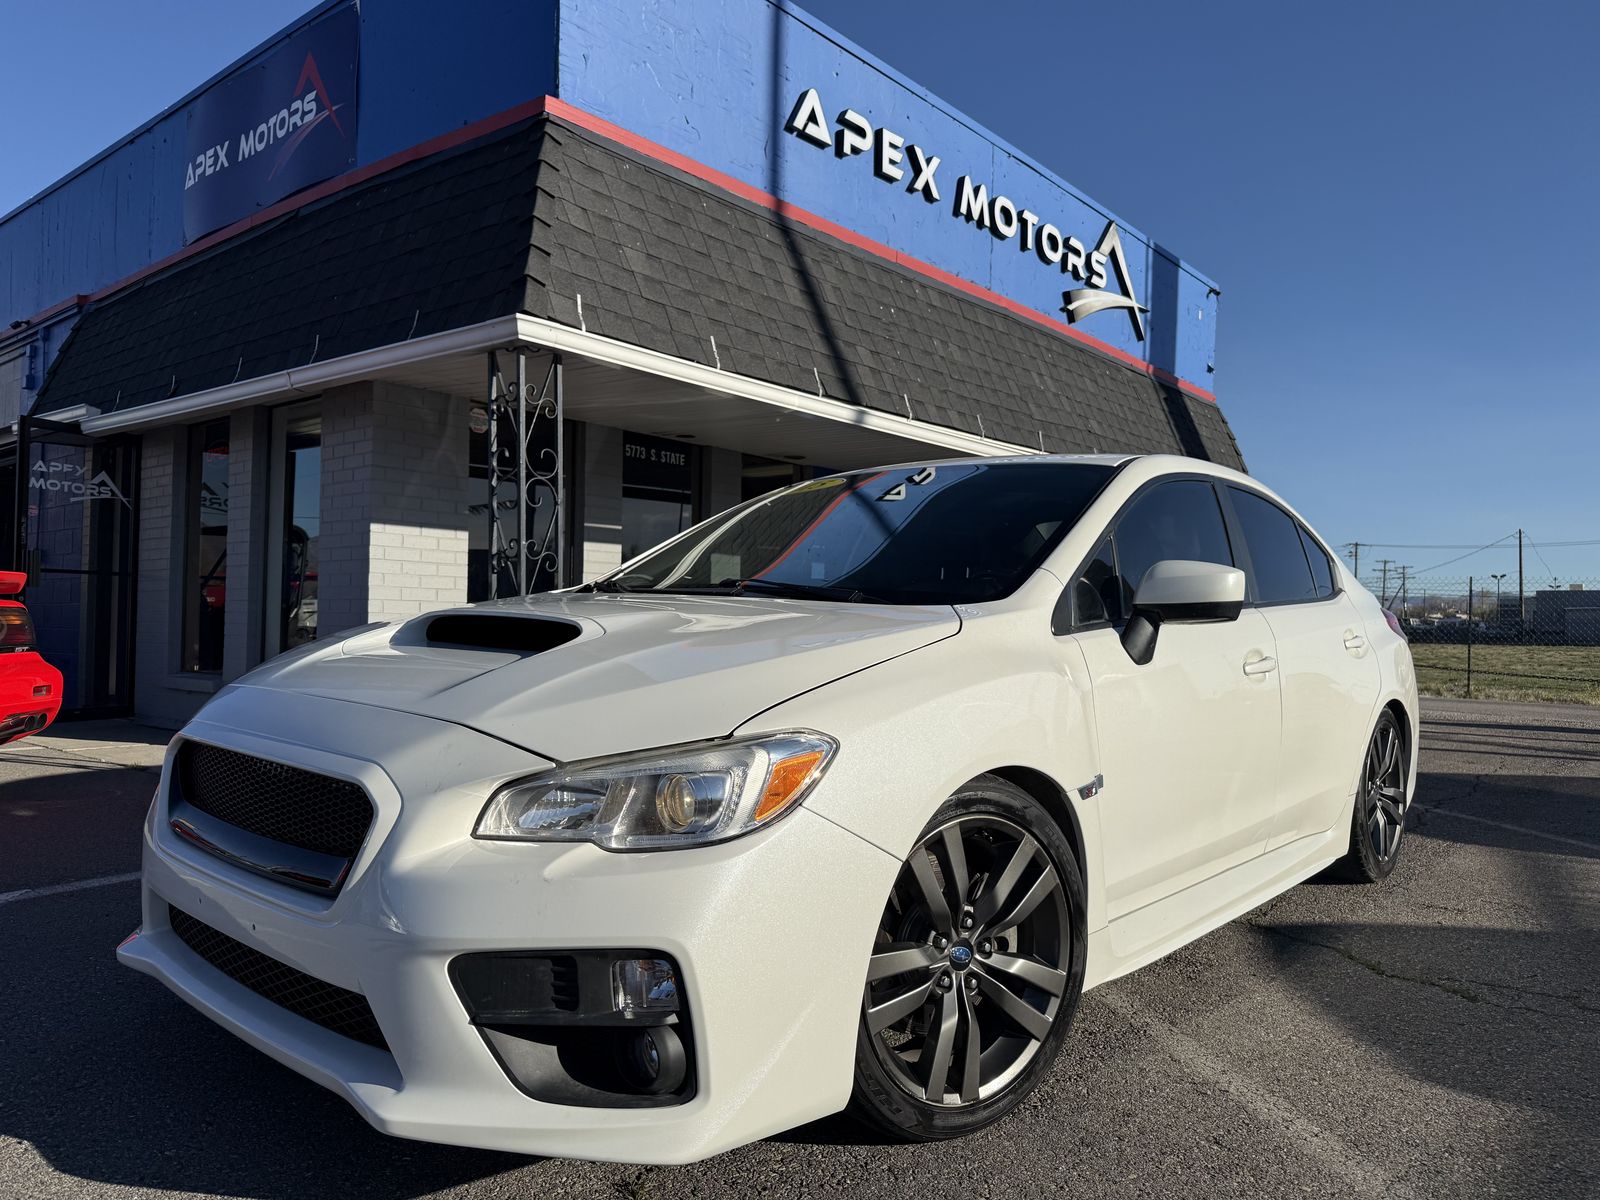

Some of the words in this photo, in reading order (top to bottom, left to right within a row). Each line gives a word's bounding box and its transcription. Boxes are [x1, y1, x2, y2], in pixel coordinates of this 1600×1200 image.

[185, 141, 229, 190] APEX
[238, 91, 317, 162] MOTORS
[785, 88, 941, 202] APEX
[953, 175, 1108, 289] MOTORS
[625, 444, 646, 459] 5773
[661, 451, 686, 466] STATE
[29, 477, 112, 497] MOTORS
